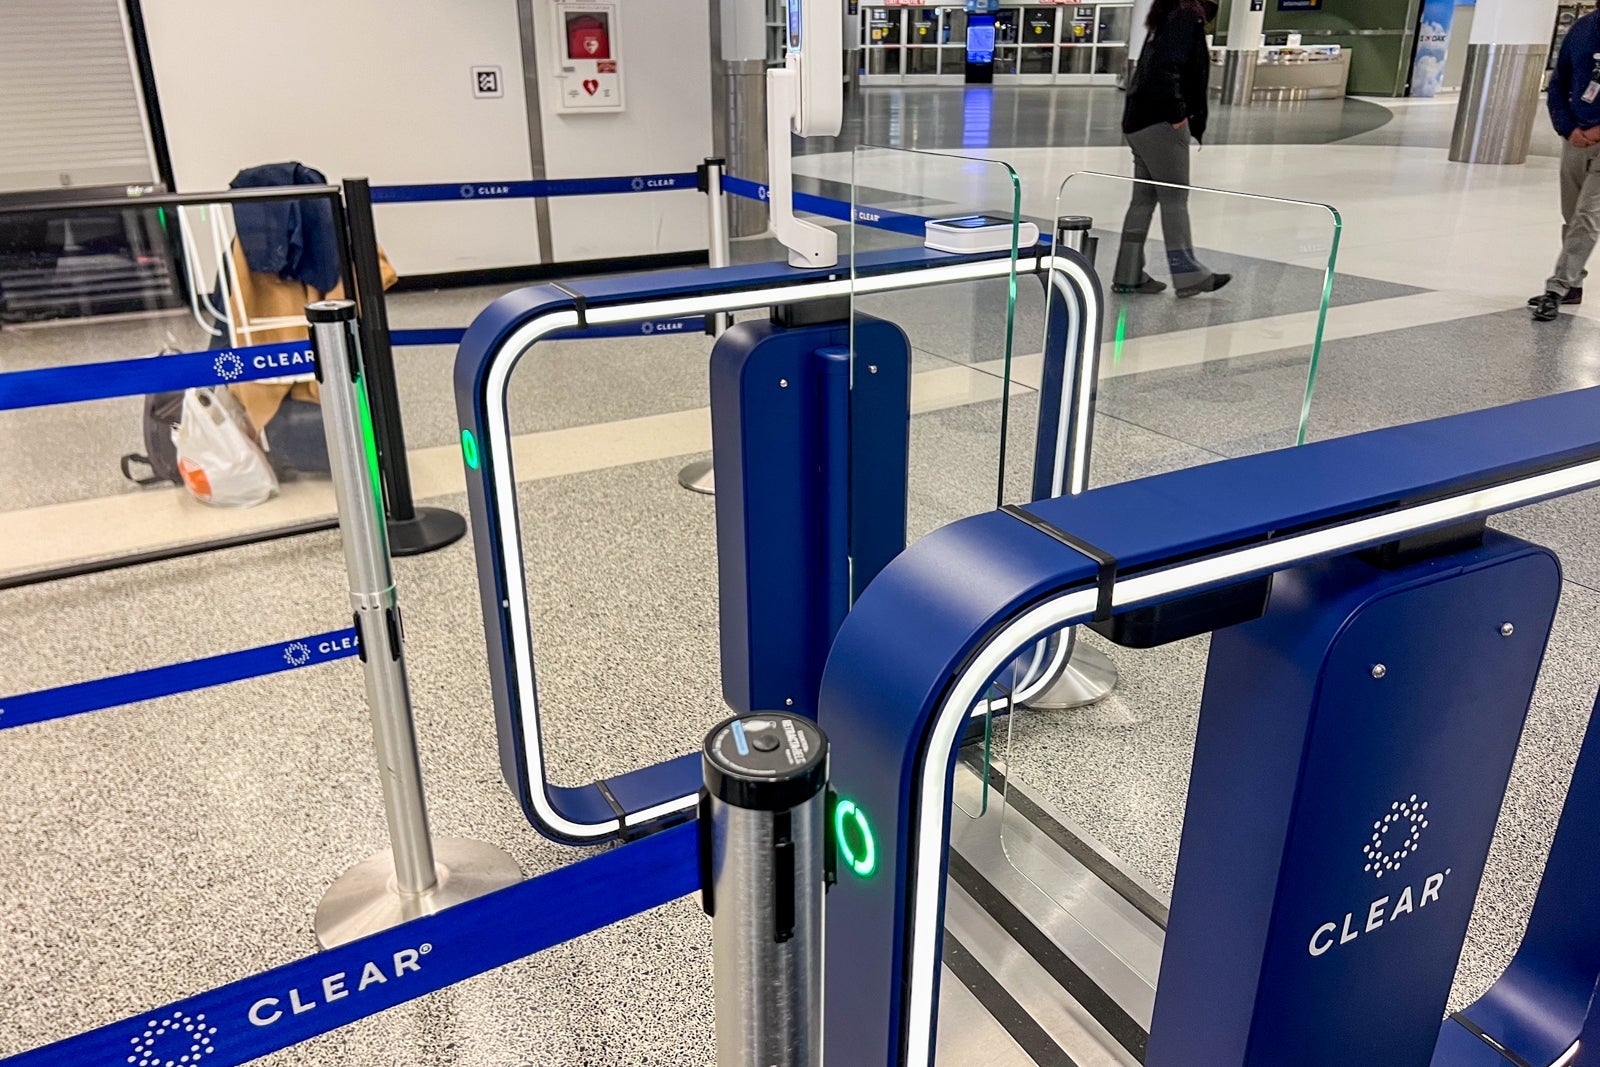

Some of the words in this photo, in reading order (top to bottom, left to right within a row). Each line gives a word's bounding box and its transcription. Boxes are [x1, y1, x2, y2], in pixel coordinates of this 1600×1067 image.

[656, 323, 683, 331] CLEAR
[253, 350, 315, 369] CLEAR
[319, 636, 359, 654] CLEA
